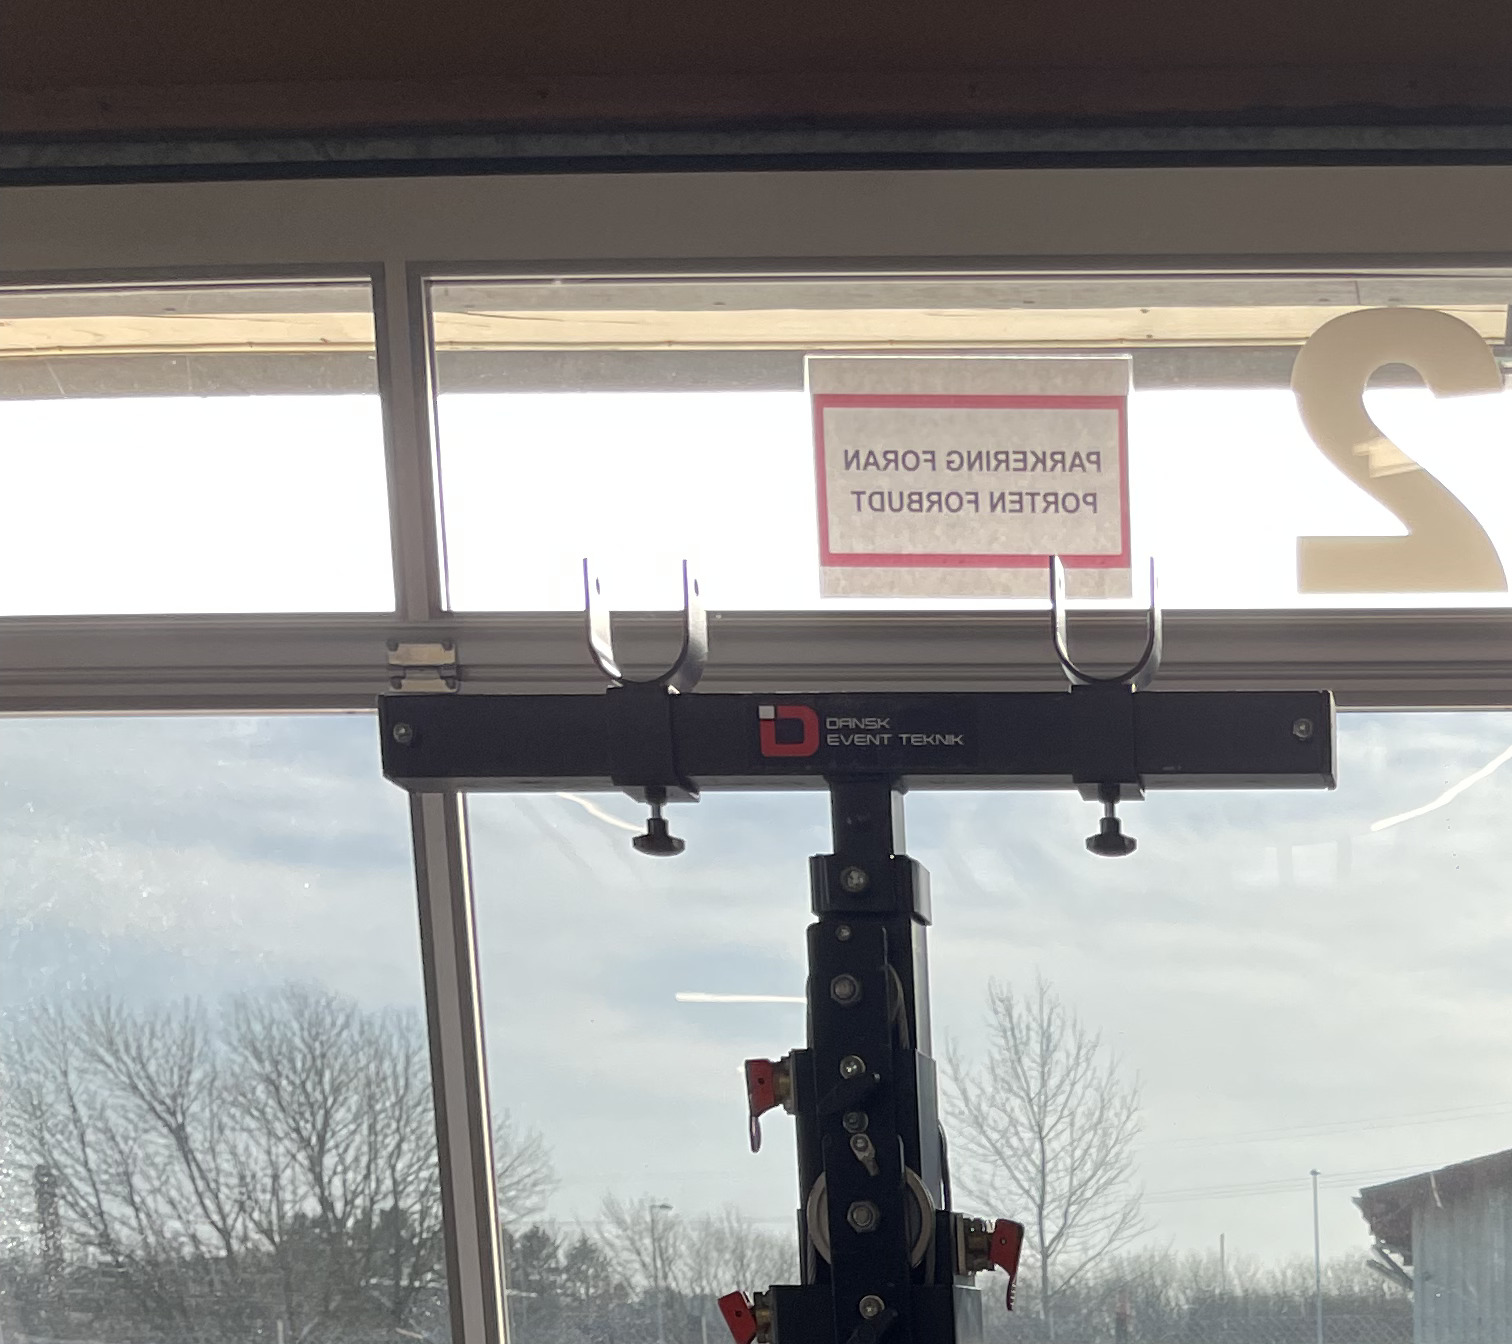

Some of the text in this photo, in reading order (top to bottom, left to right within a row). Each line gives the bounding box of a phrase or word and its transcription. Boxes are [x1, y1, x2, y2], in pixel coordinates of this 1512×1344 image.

[826, 717, 891, 730] DANSK
[827, 734, 964, 746] EVENT TEKNIK
